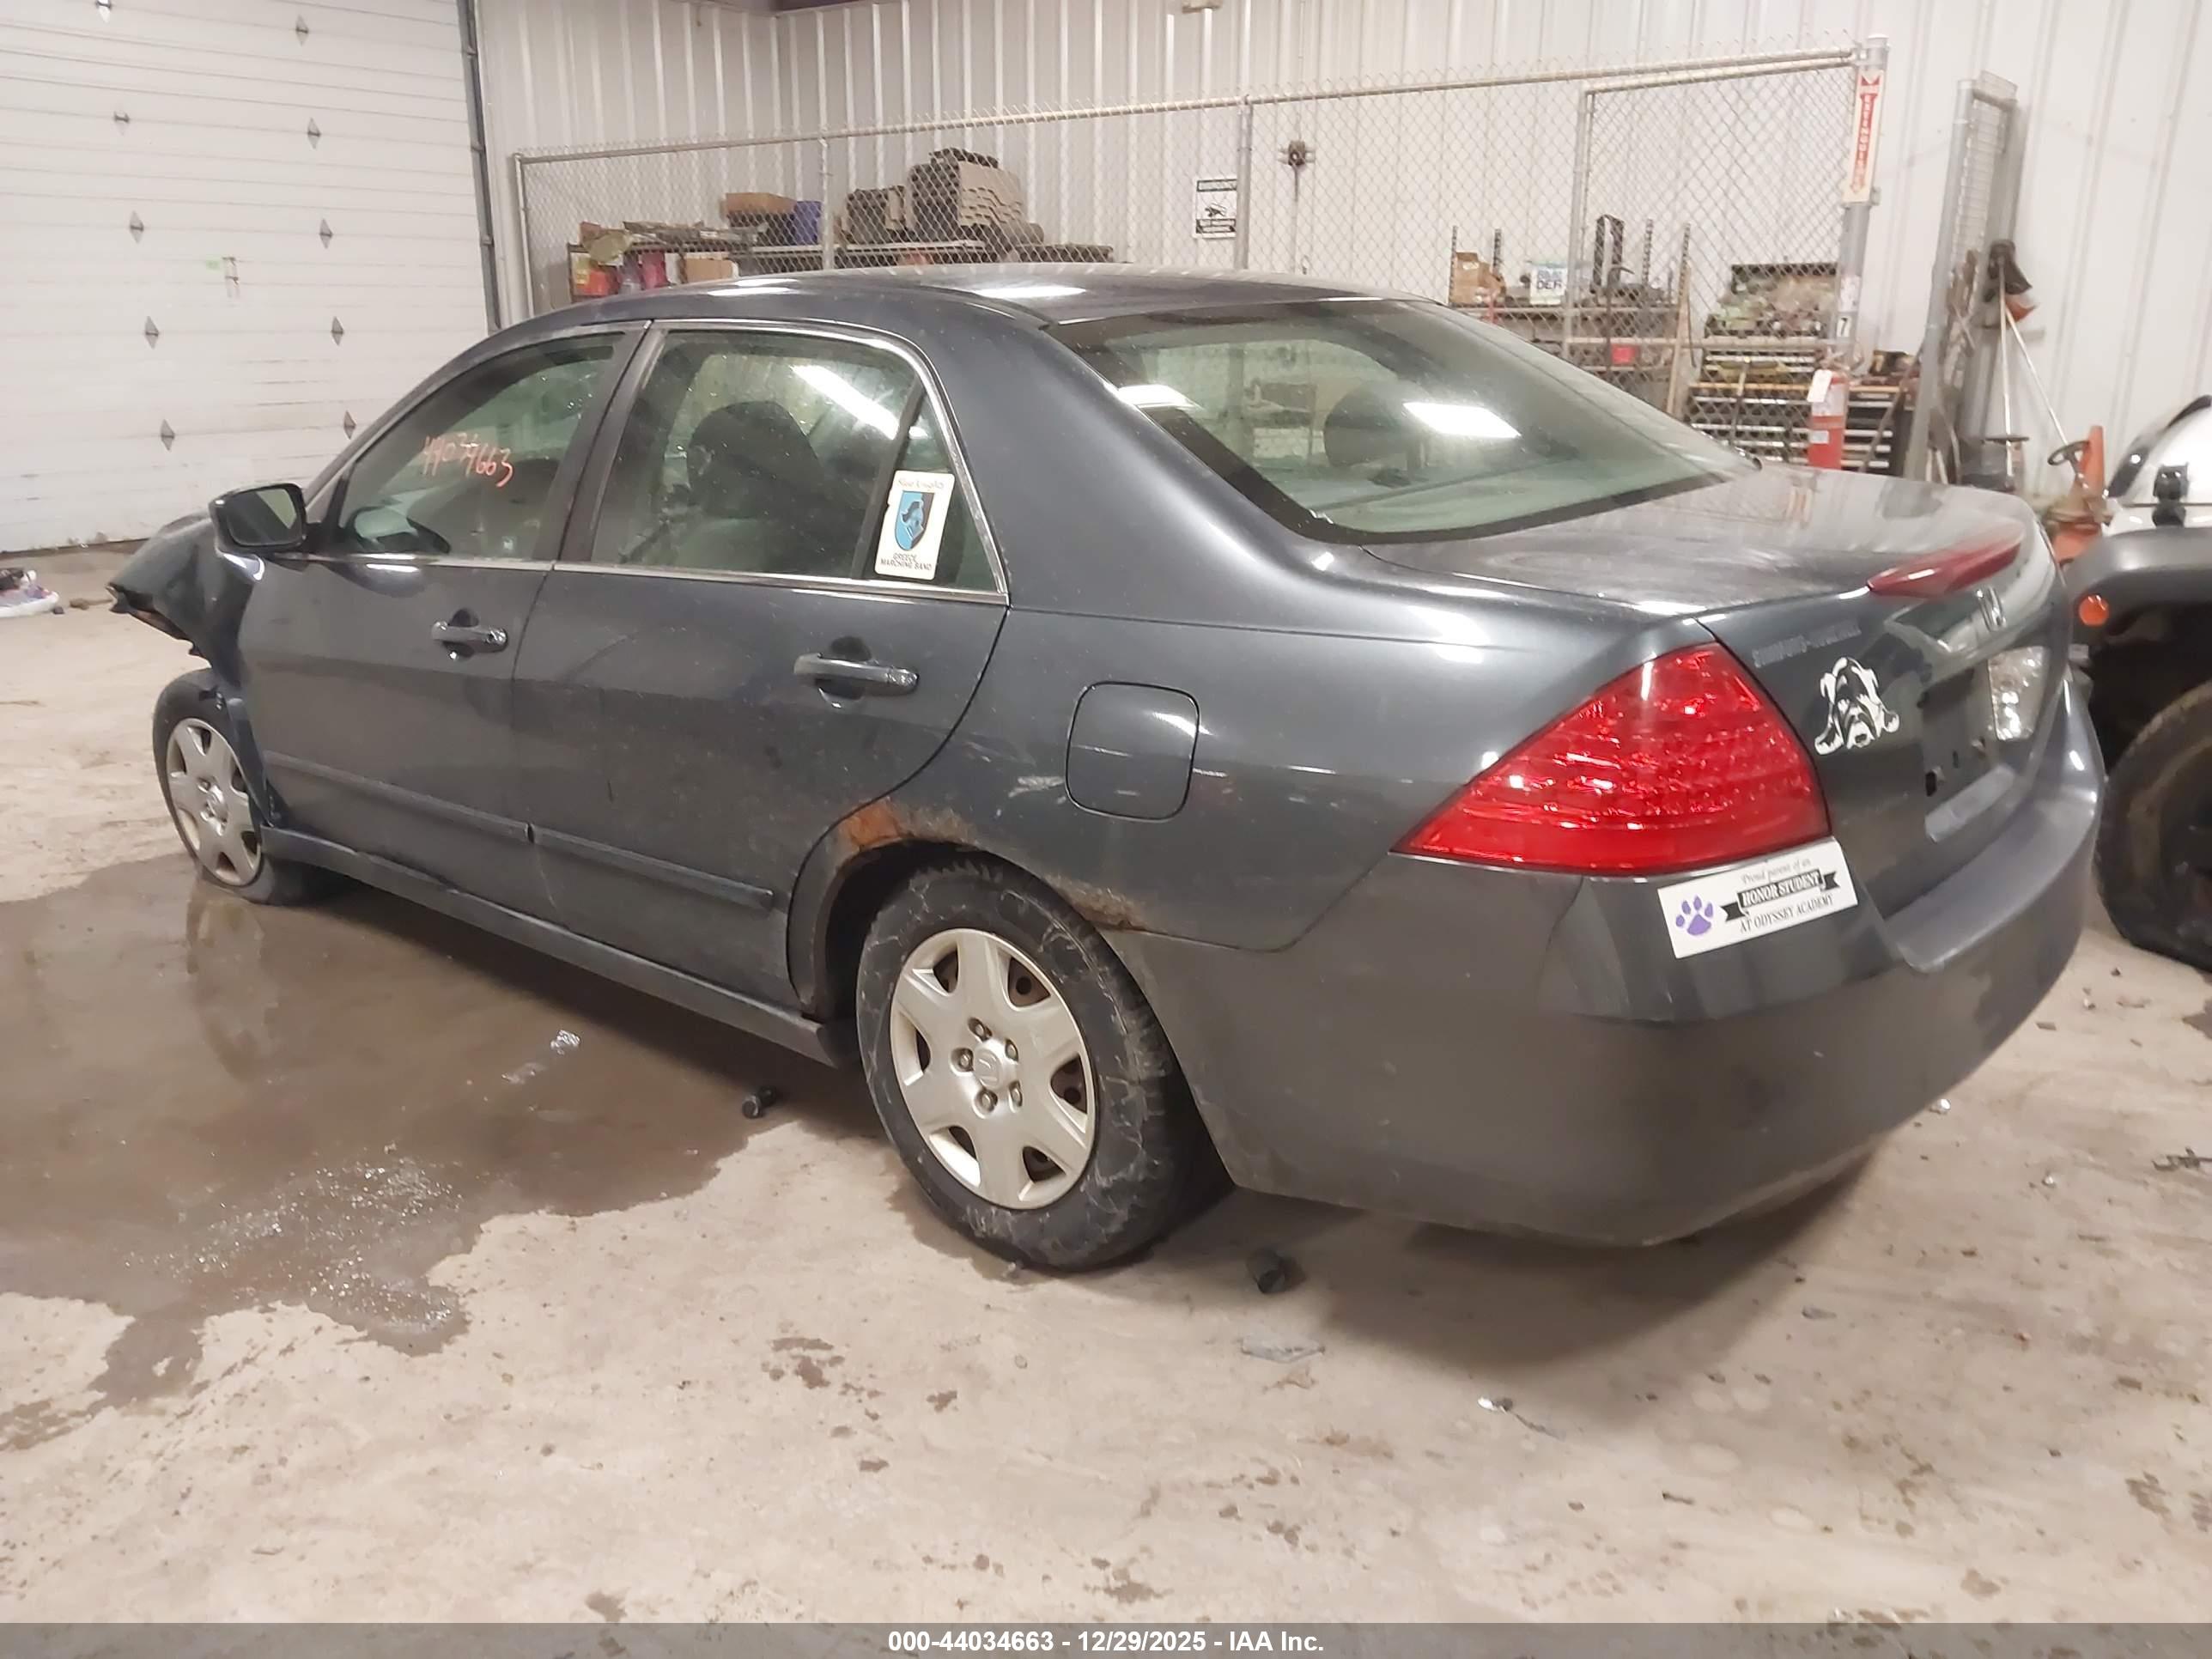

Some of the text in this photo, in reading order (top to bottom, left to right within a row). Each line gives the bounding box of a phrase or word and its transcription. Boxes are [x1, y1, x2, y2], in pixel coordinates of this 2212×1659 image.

[1741, 870, 1765, 884] Proud
[1767, 863, 1792, 882] parent
[1741, 870, 1820, 908] HONOR STUDENT
[1740, 894, 1833, 933] AT ODYSSEY ACADEMY
